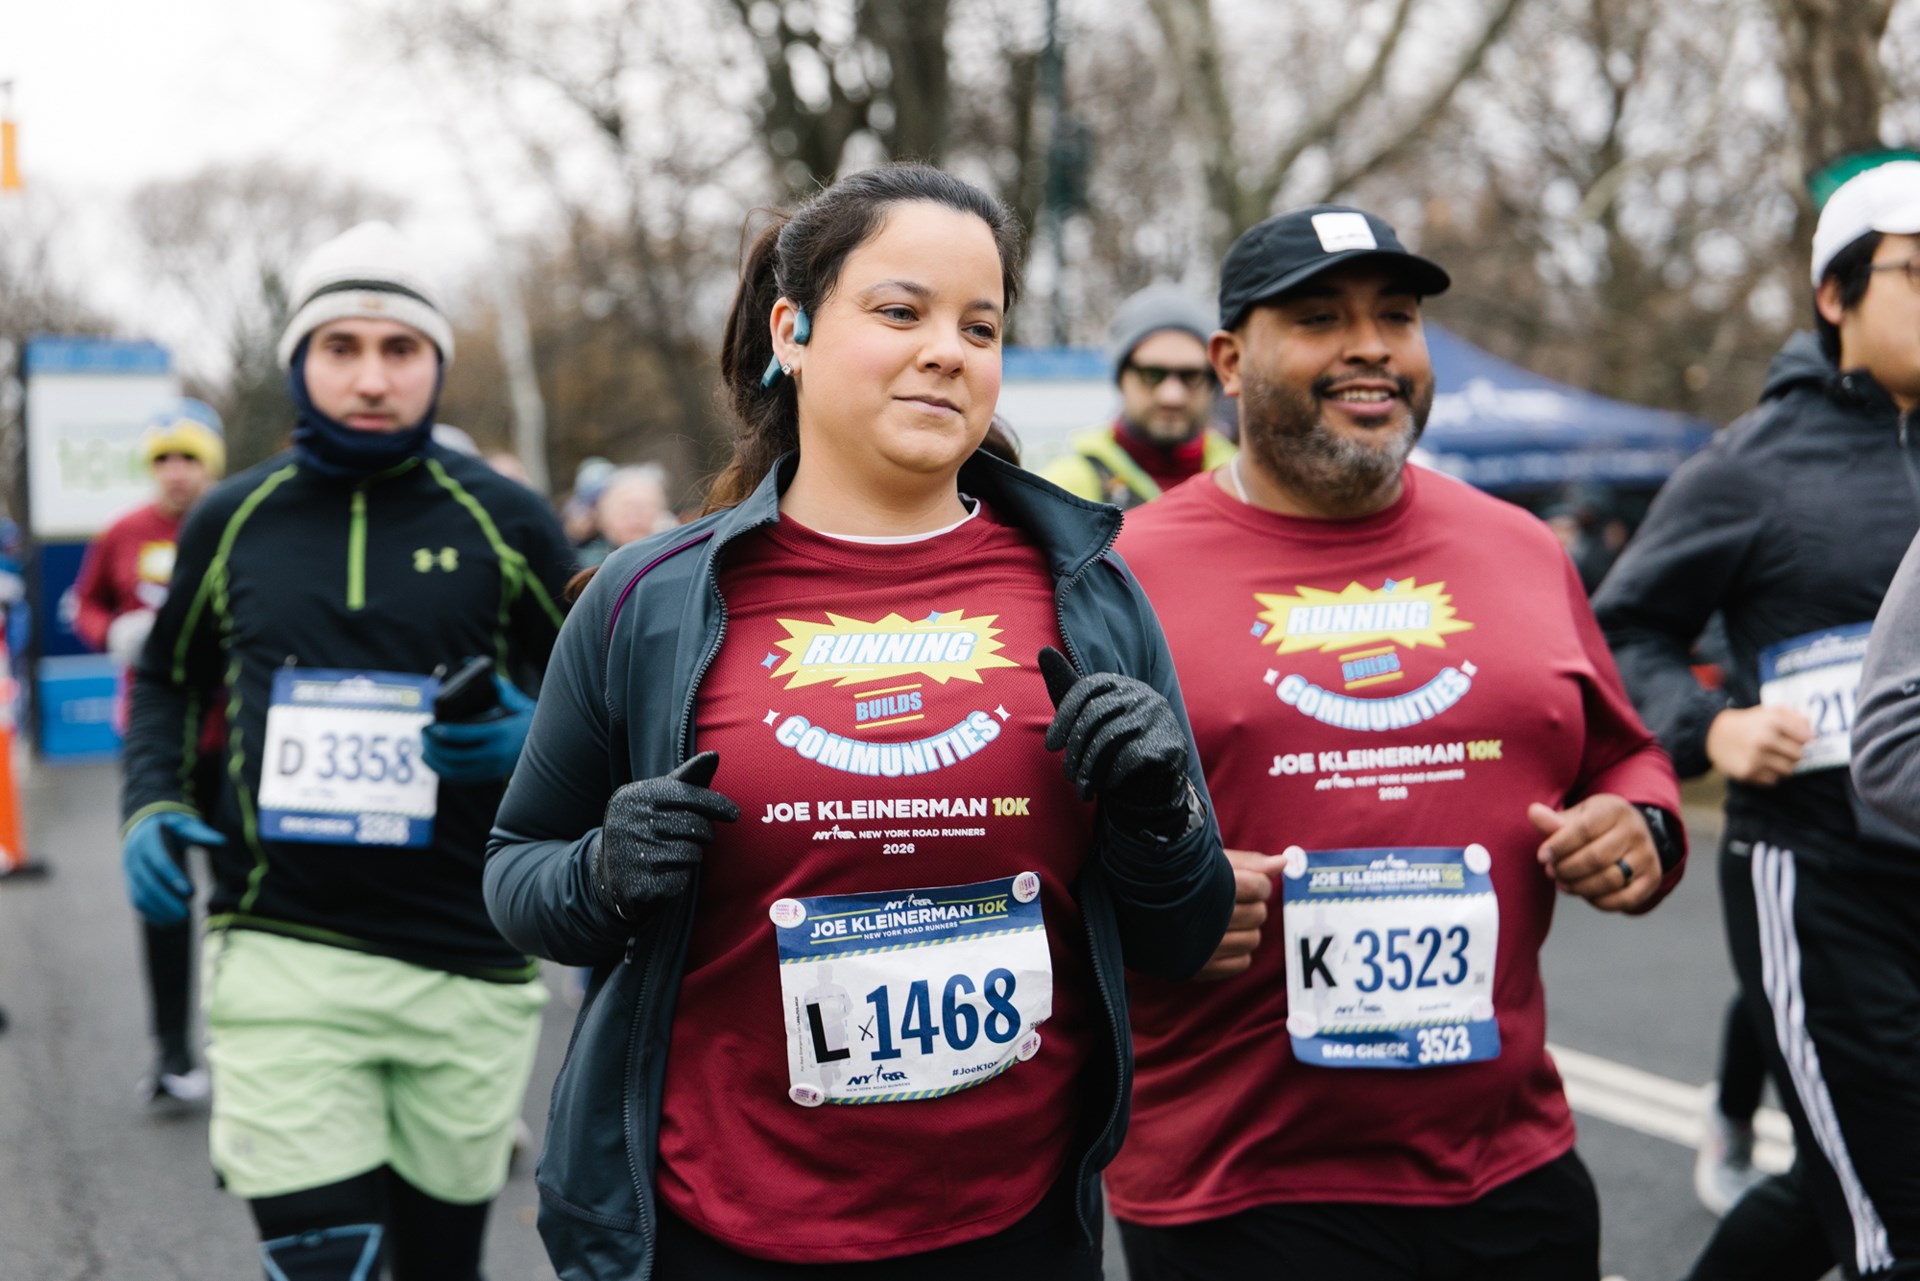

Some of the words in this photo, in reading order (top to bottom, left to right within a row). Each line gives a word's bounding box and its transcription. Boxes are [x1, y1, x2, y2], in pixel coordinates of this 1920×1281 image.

[1286, 600, 1432, 635] RUNNING
[801, 631, 978, 666] RUNNING
[1342, 652, 1400, 682] BUILDS
[856, 691, 922, 721] BUILDS
[1276, 667, 1471, 731] COMMUNITIES
[1808, 687, 1858, 736] 21
[278, 738, 306, 776] D
[317, 731, 414, 784] 3358
[775, 710, 1001, 777] COMMUNITIES
[1268, 753, 1315, 776] JOE
[1318, 742, 1465, 772] KLEINERMAN
[1466, 740, 1502, 760] 10K
[761, 801, 810, 823] JOE
[818, 798, 987, 820] KLEINERMAN
[992, 797, 1030, 816] 10K
[859, 830, 882, 839] NEW
[883, 829, 910, 838] YORK
[912, 829, 939, 838] ROAD
[941, 828, 986, 837] RUNNERS
[883, 843, 915, 855] 2026
[1308, 872, 1340, 888] JOE
[1343, 868, 1441, 886] KLEINERMAN
[810, 919, 847, 938] JOE
[851, 904, 973, 933] KLEINERMAN
[977, 900, 1007, 915] 10K
[864, 932, 881, 940] NEW
[882, 929, 901, 938] YORK
[903, 927, 923, 935] ROAD
[925, 922, 958, 932] RUNNERS
[1300, 935, 1338, 989] K
[1354, 925, 1470, 993] 3523
[806, 1002, 850, 1063] L
[866, 968, 1021, 1061] 1468
[1321, 1044, 1353, 1059] BAG
[1355, 1041, 1410, 1058] CHECK
[1416, 1025, 1472, 1064] 3523
